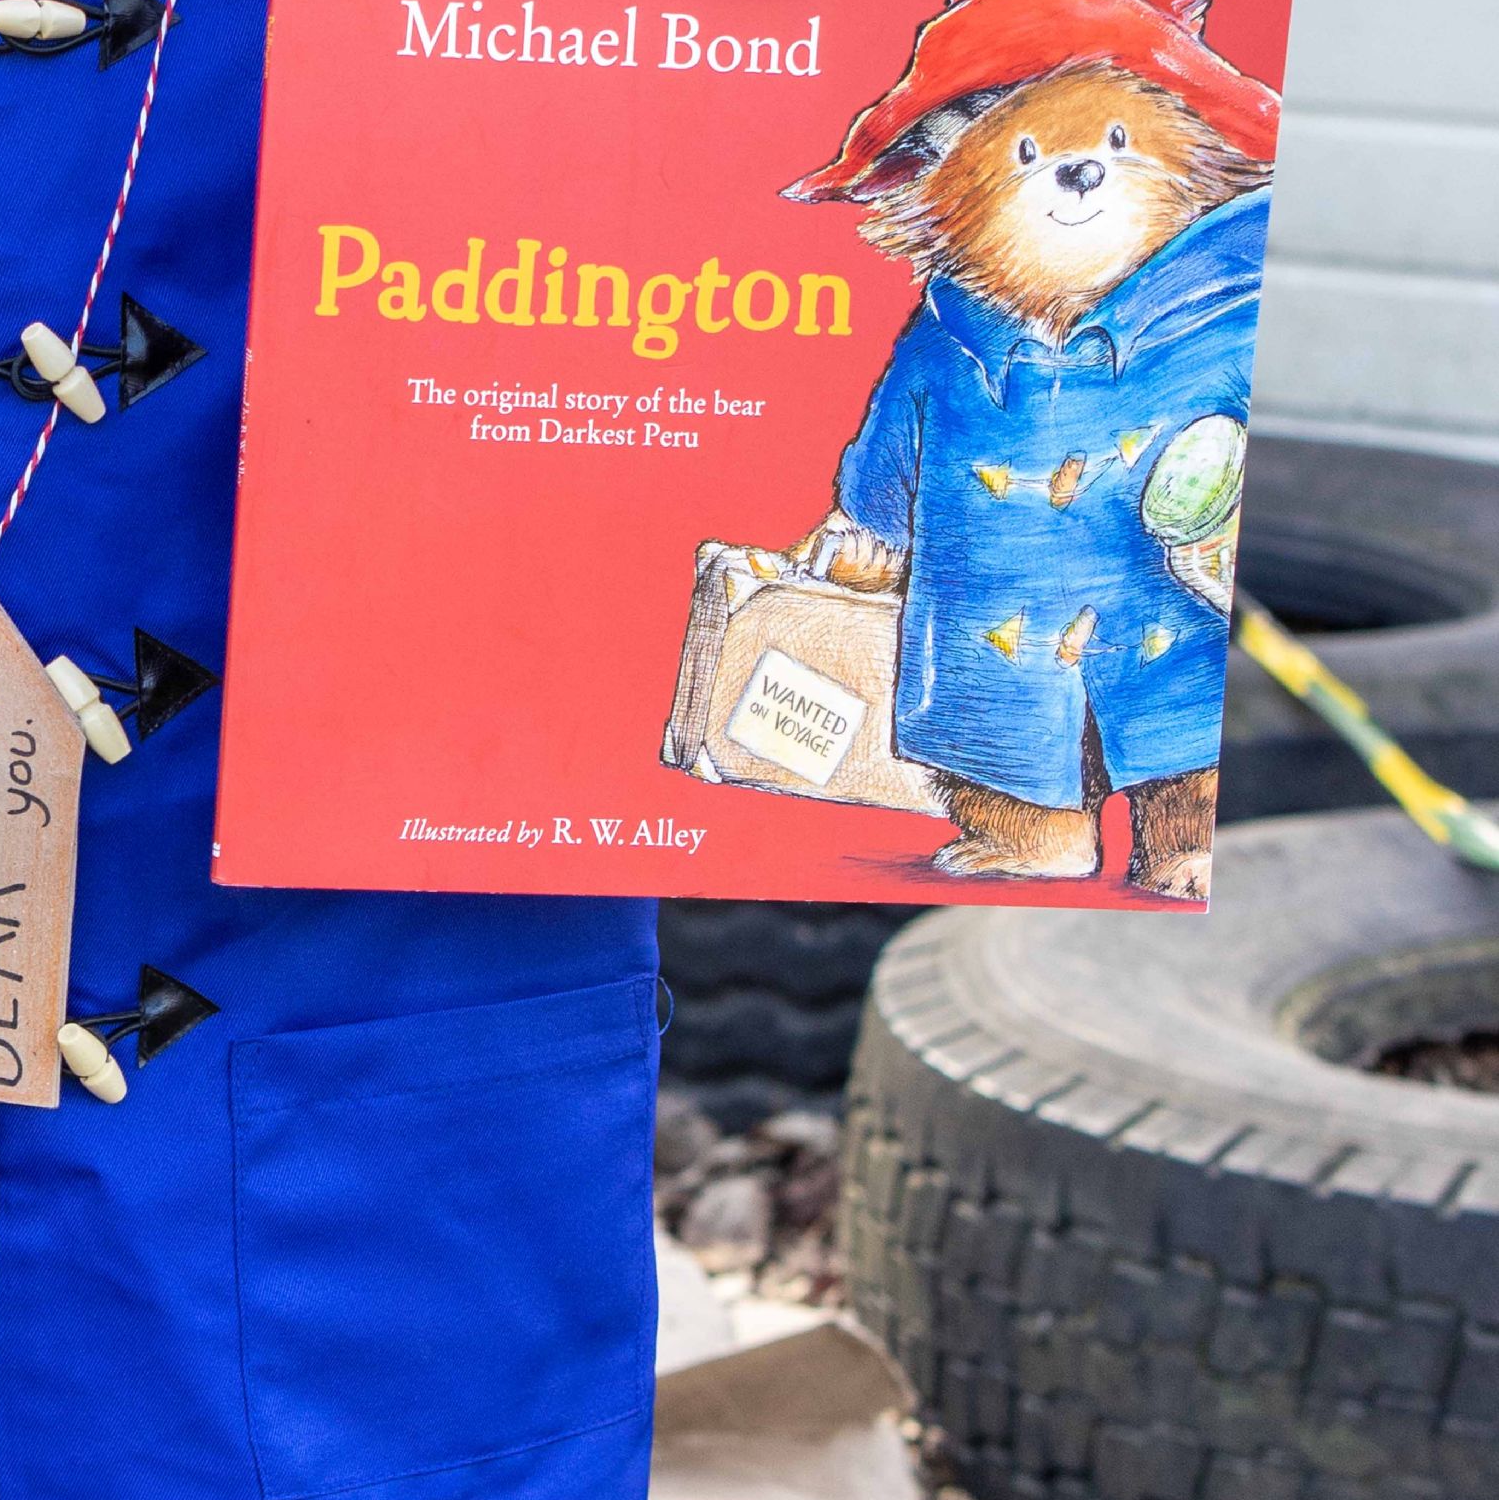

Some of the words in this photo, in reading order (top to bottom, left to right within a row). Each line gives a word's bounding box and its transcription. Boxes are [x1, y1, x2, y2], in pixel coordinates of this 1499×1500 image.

[396, 0, 638, 68] Michael
[657, 12, 822, 77] Bond
[314, 224, 853, 359] Paddington
[407, 378, 457, 405] The
[463, 381, 558, 414] original
[564, 389, 628, 419] story
[635, 386, 664, 413] of
[667, 389, 707, 415] the
[713, 389, 766, 417] bear
[469, 414, 531, 443] from
[539, 418, 636, 446] Darkest
[643, 422, 700, 449] Peru
[749, 701, 770, 721] ON
[774, 710, 835, 758] VOYAGE
[761, 674, 847, 736] WANTED
[6, 717, 52, 828] you.
[398, 817, 514, 844] Illustrated
[517, 820, 543, 849] by
[551, 817, 583, 845] R.
[589, 817, 625, 846] W.
[630, 818, 708, 855] Alley
